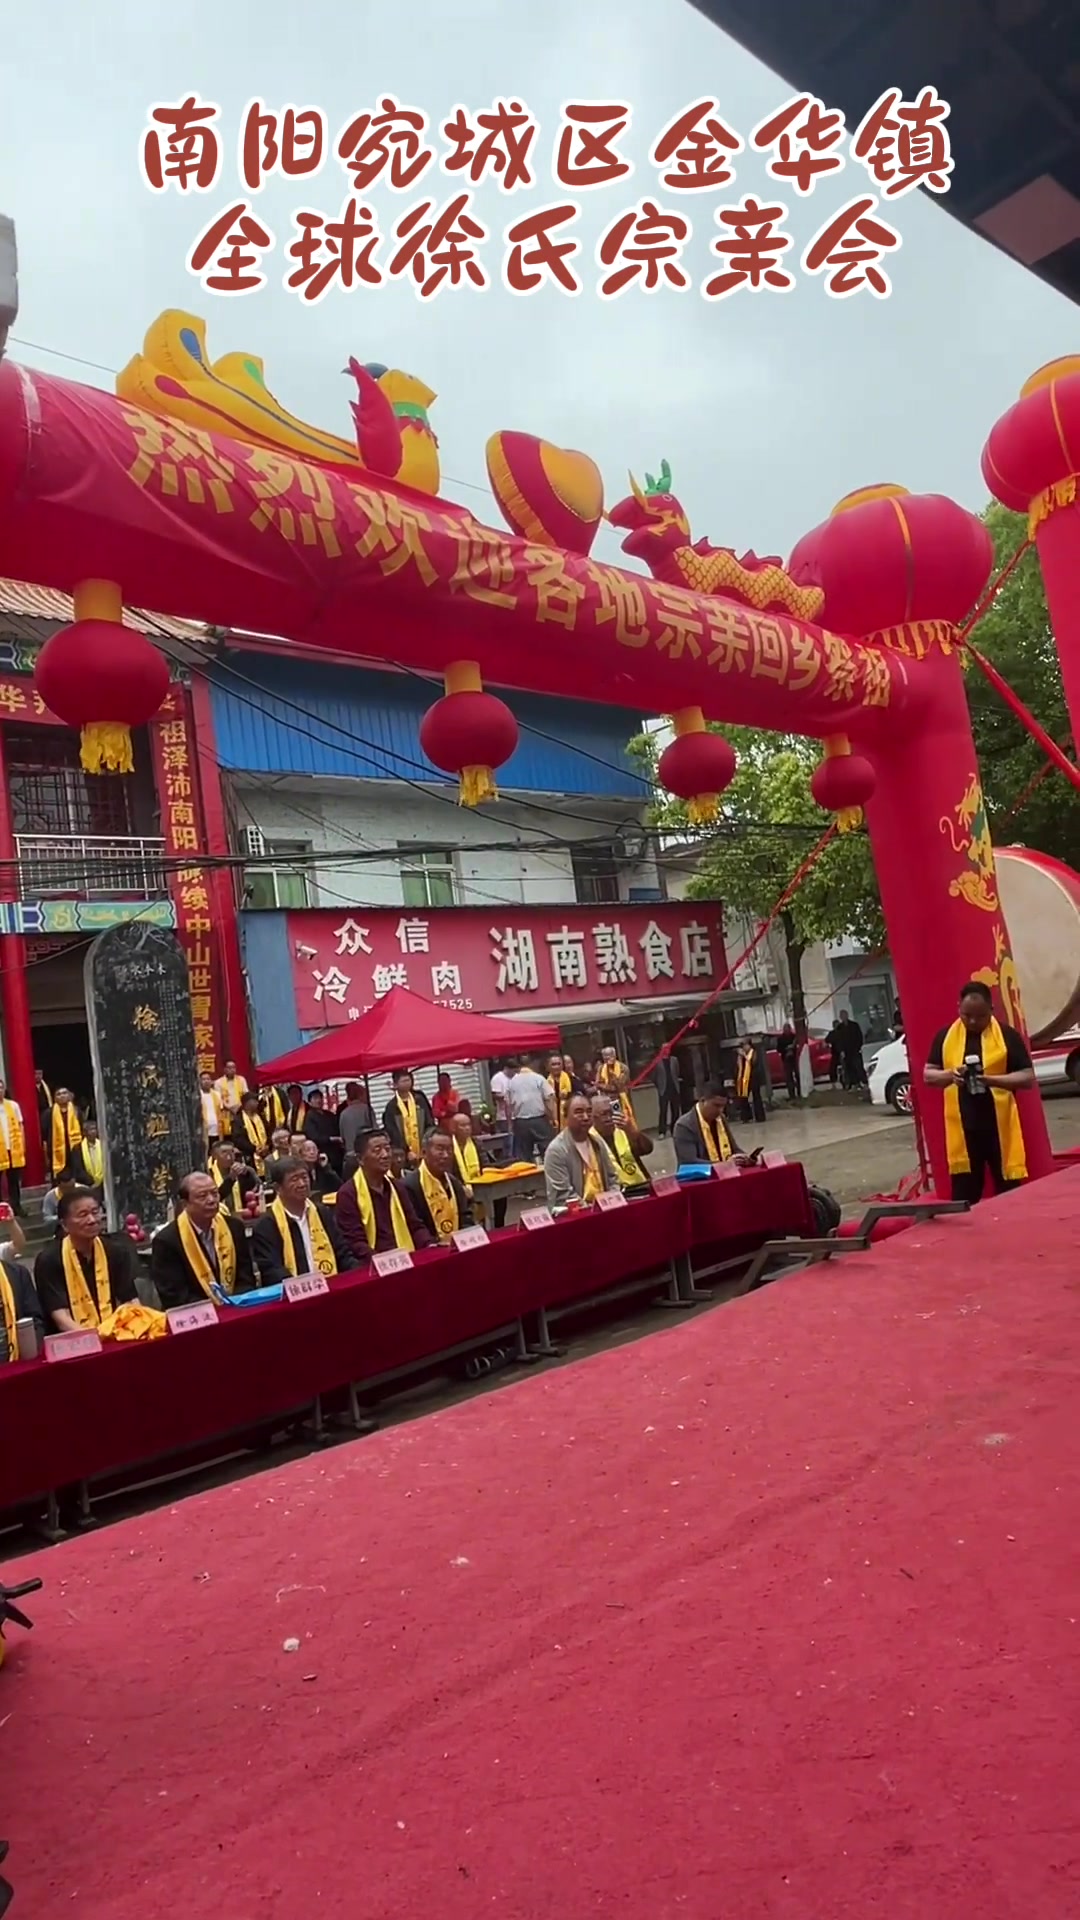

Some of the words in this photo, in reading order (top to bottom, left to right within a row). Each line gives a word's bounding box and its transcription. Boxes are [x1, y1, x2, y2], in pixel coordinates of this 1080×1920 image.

[122, 406, 890, 707] 热烈欢迎各地宗亲回乡祭祖
[333, 917, 432, 957] 众信
[489, 920, 714, 994] 湖南熟食店
[312, 961, 463, 1004] 冷鲜肉
